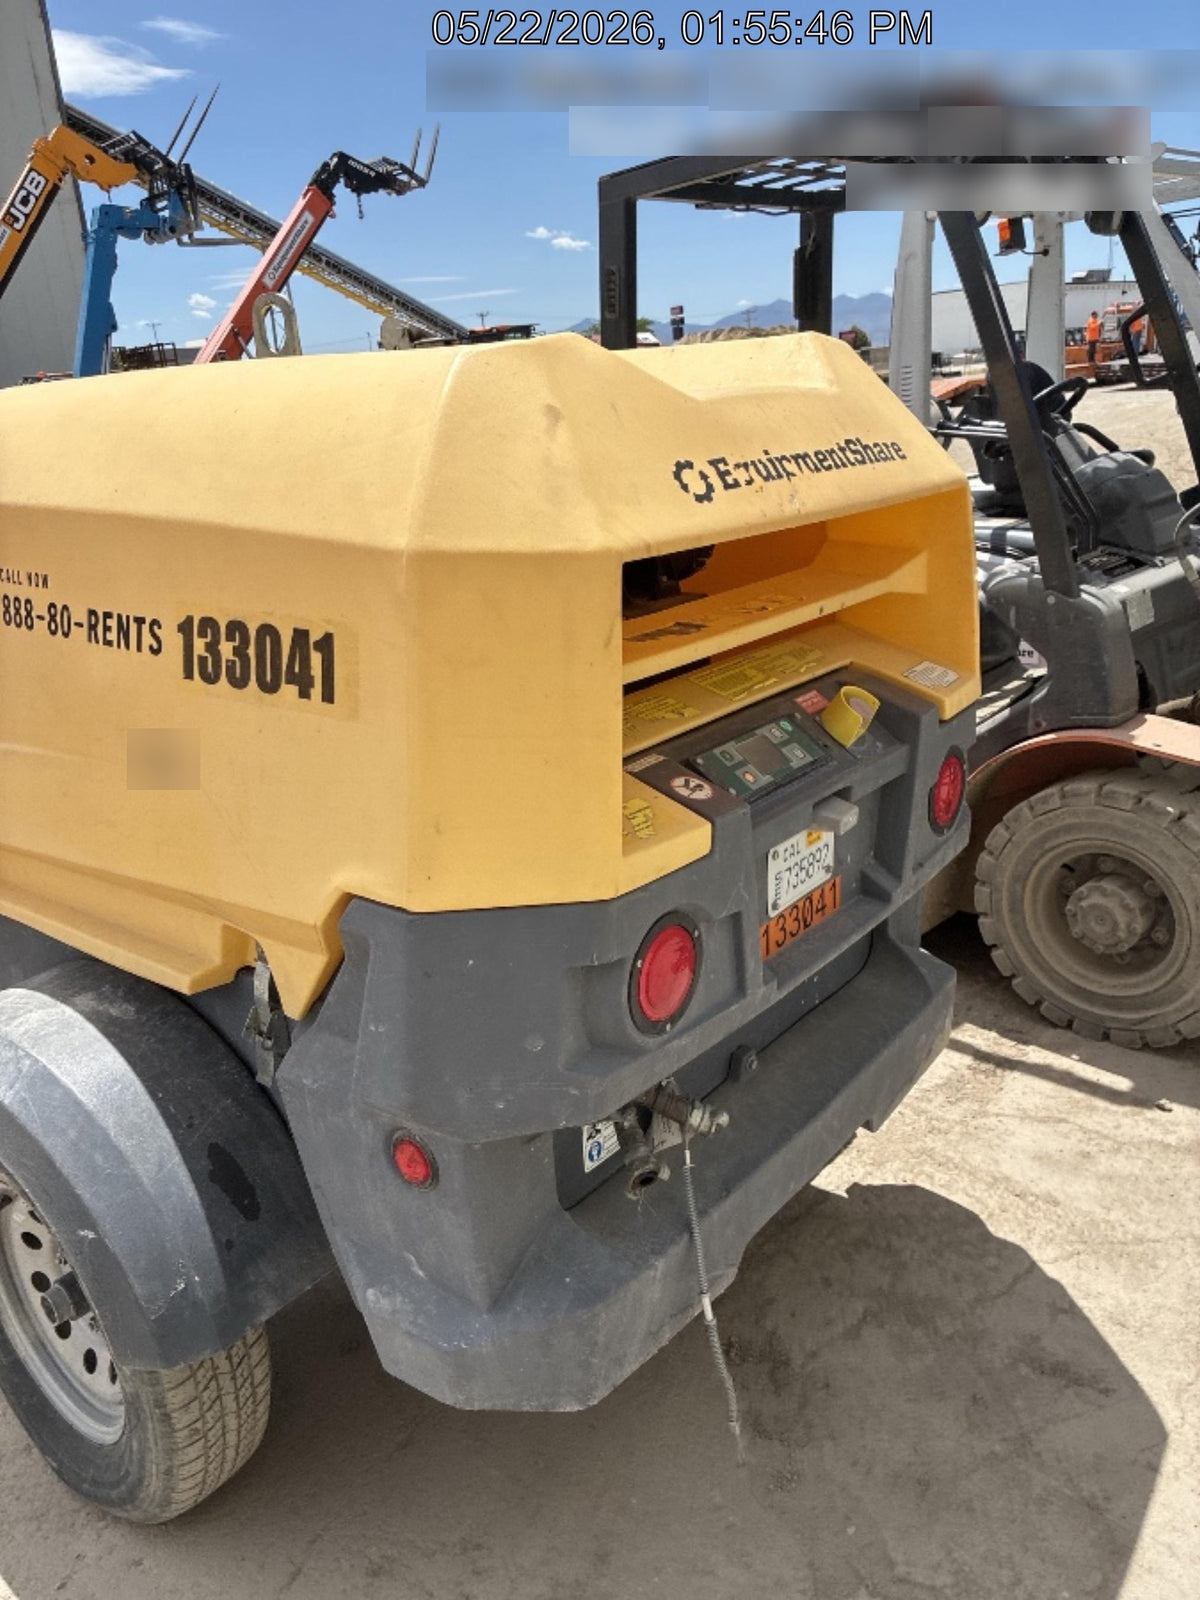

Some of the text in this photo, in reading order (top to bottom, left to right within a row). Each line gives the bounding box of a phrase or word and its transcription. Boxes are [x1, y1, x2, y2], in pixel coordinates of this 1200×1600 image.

[10, 170, 47, 230] JCB
[27, 572, 49, 589] NOW
[3, 593, 163, 656] 888-80-RENTS
[177, 615, 335, 704] 133041
[762, 878, 838, 956] 133041
